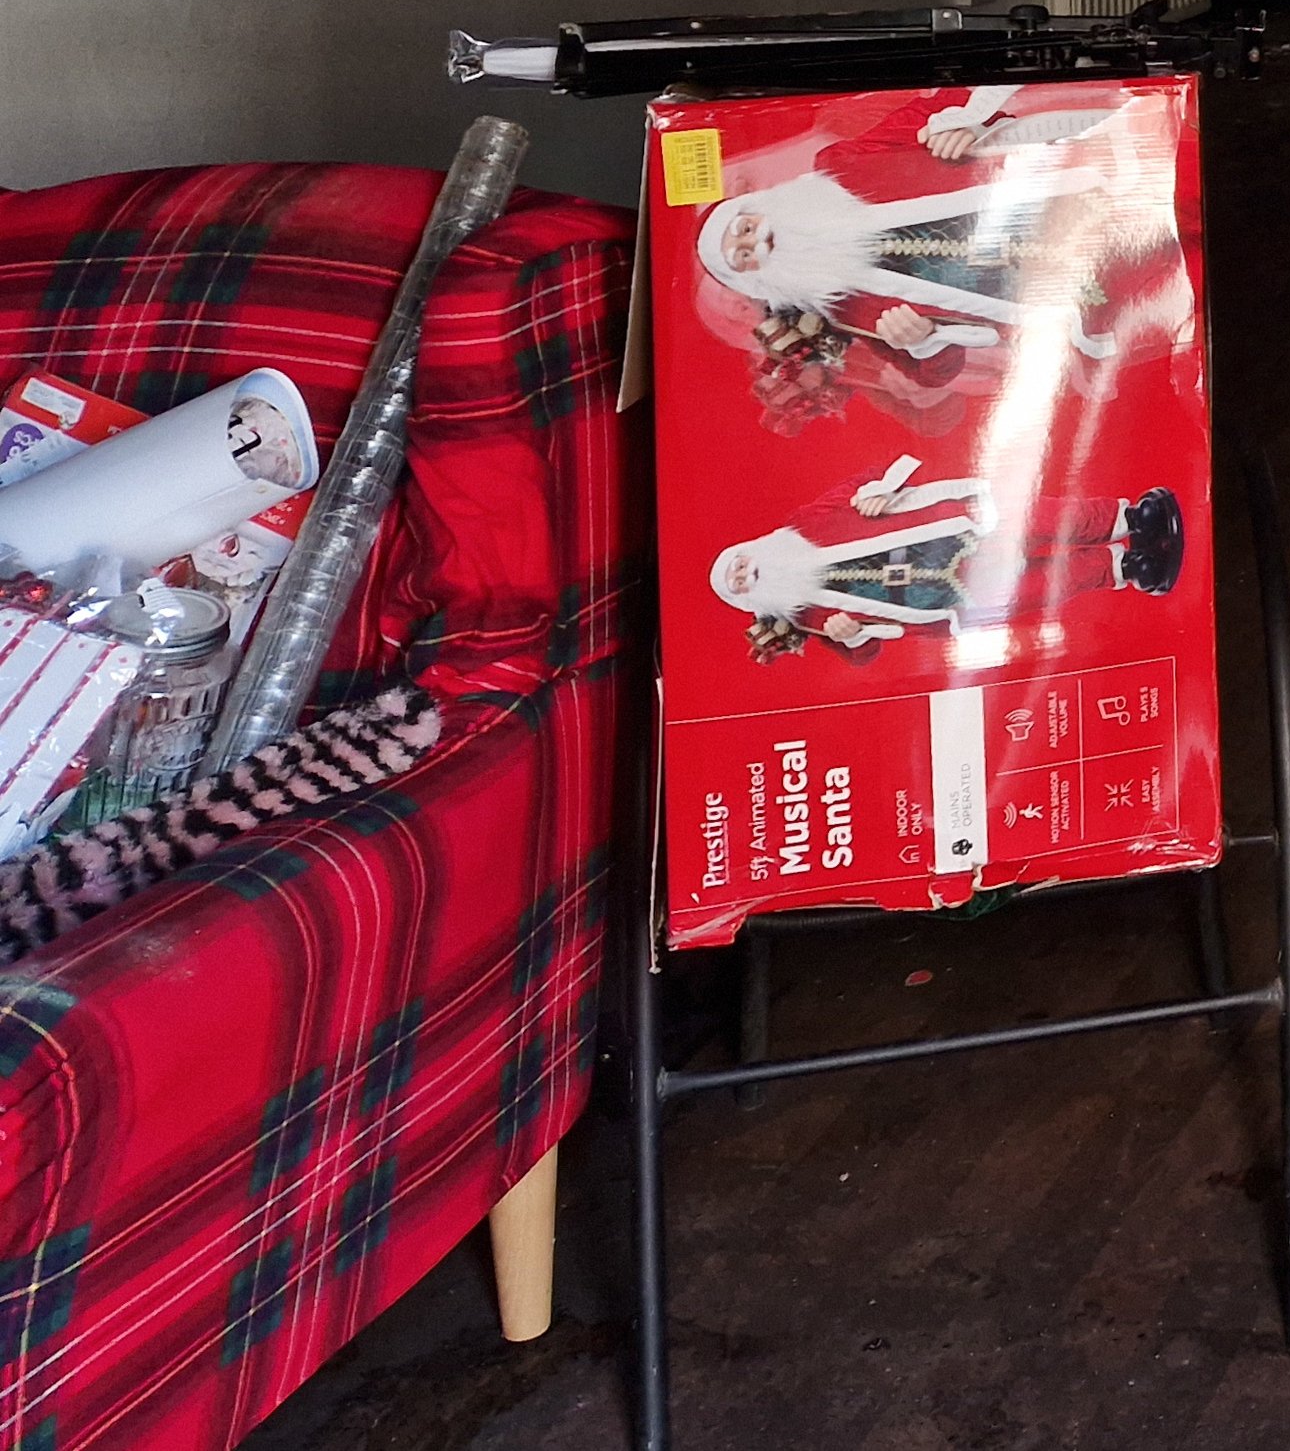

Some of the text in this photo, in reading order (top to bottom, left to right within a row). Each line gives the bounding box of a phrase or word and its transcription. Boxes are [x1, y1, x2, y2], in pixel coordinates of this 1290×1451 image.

[1048, 690, 1059, 749] ADJUSTABLE
[1059, 698, 1070, 738] VOLUME
[1140, 693, 1149, 723] PLAYS
[1149, 687, 1159, 718] SONGS
[773, 739, 812, 876] Musical
[895, 787, 908, 838] INDOOR
[951, 790, 961, 830] MAINS
[962, 762, 972, 827] OPERATED
[1050, 770, 1060, 844] MOTION SENSOR
[1059, 780, 1070, 831] ACTIVATED
[1141, 779, 1150, 803] EASY
[1150, 765, 1162, 813] ASSEMBLY
[700, 792, 730, 889] Prestige
[746, 761, 777, 881] 5ft Animated
[820, 766, 854, 869] Santa
[911, 801, 924, 836] ONLY
